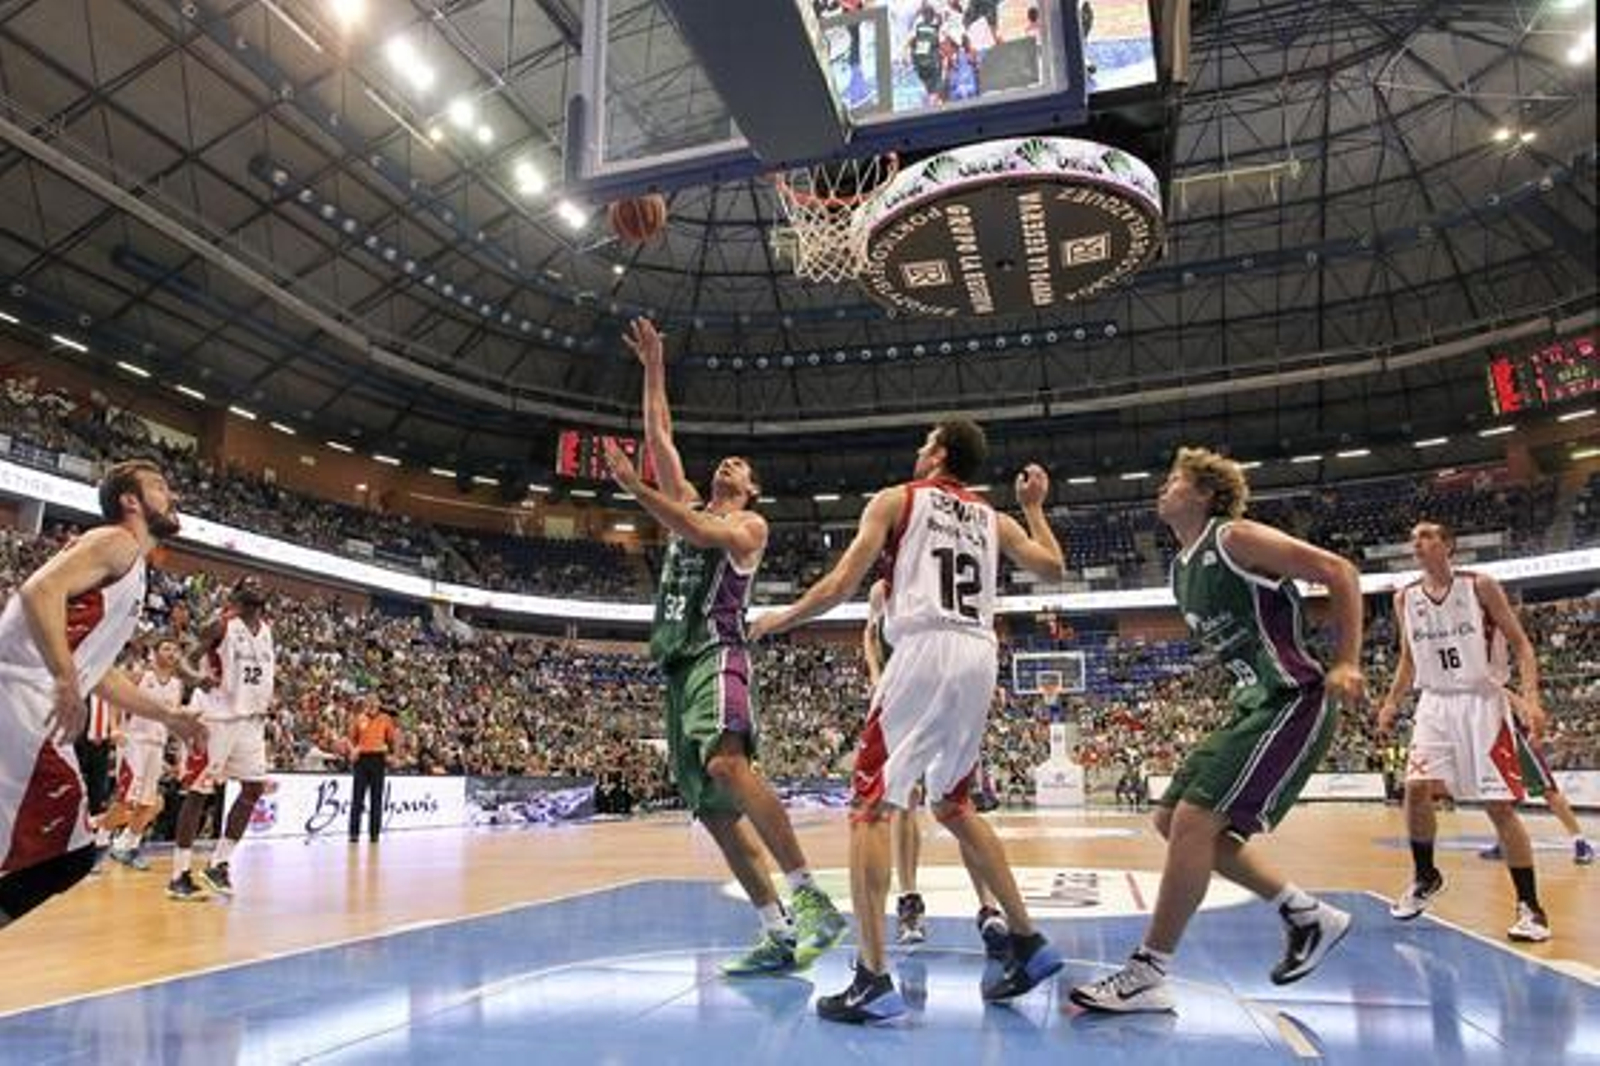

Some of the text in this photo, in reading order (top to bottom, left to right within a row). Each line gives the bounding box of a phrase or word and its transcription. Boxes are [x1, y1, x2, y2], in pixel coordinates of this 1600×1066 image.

[931, 547, 982, 620] 12
[1438, 647, 1461, 670] 16
[305, 779, 438, 832] Behavis
